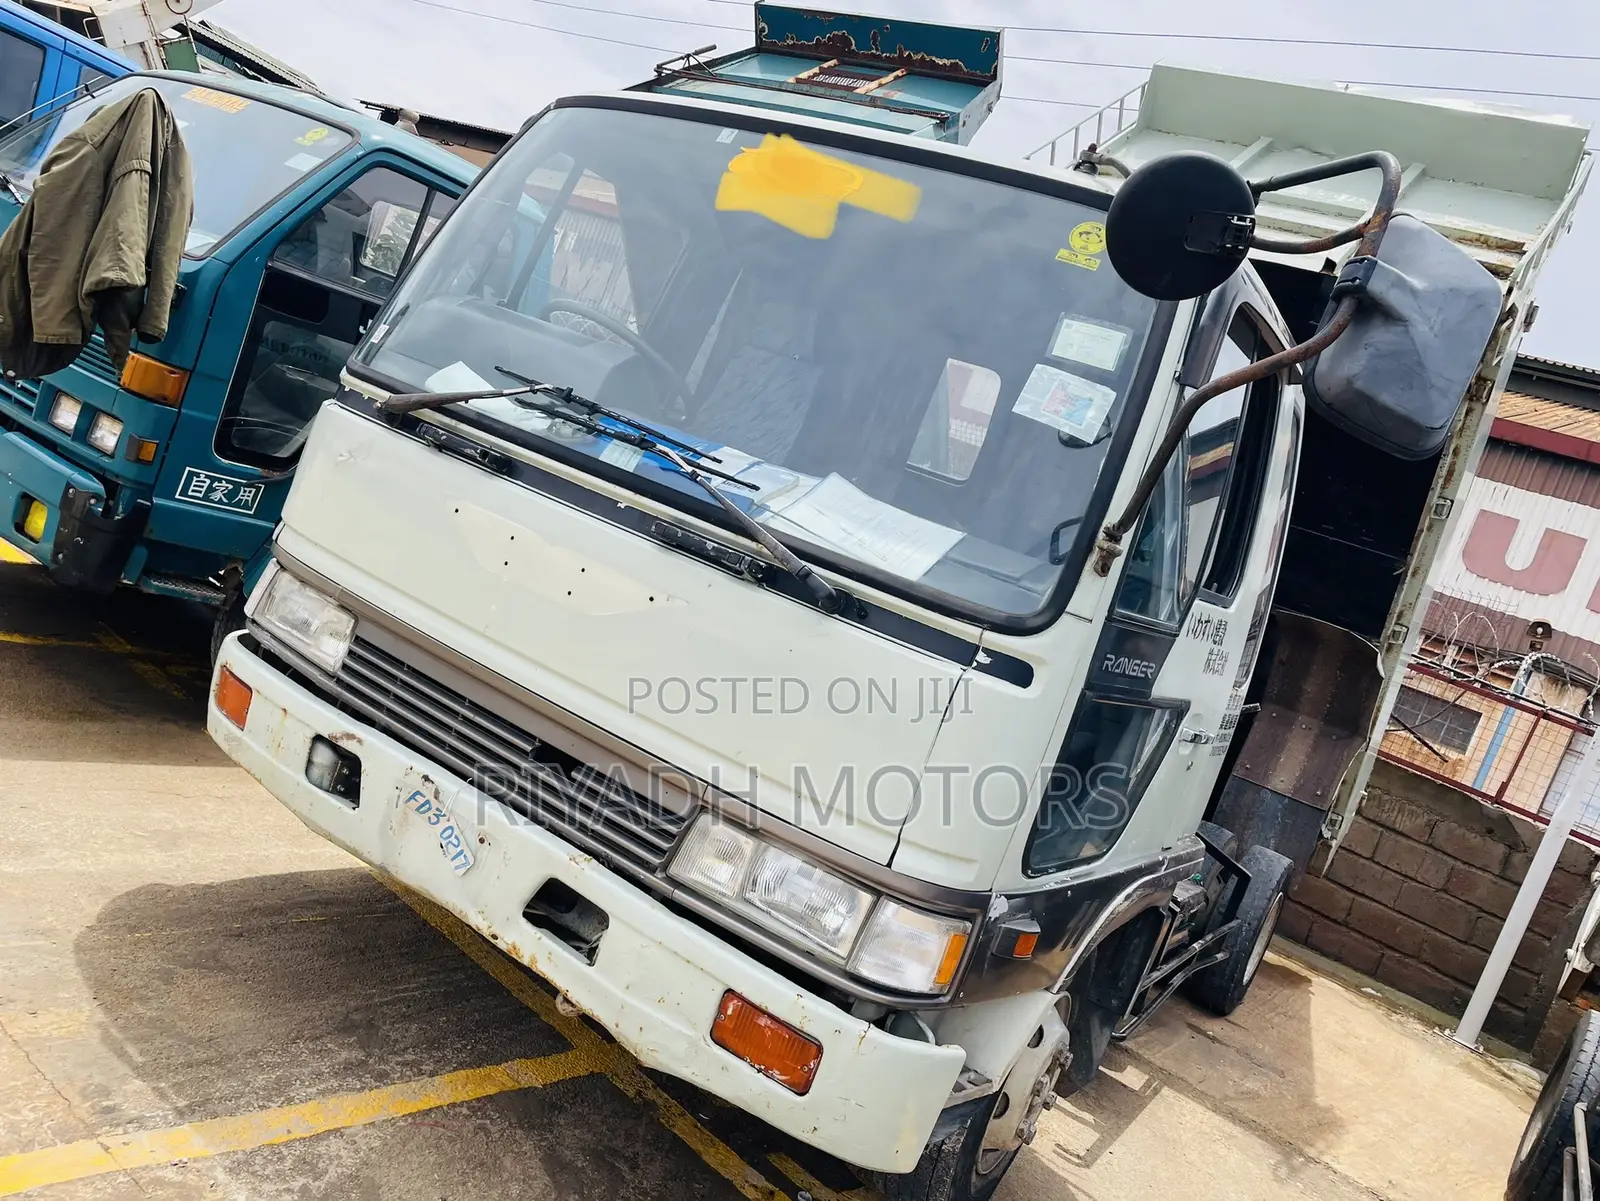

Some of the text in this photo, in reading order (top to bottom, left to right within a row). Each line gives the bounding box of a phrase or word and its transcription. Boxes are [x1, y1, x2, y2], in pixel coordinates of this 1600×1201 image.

[187, 473, 257, 507] 自家用
[1102, 653, 1156, 679] RANGER
[404, 790, 471, 871] FD3 0217
